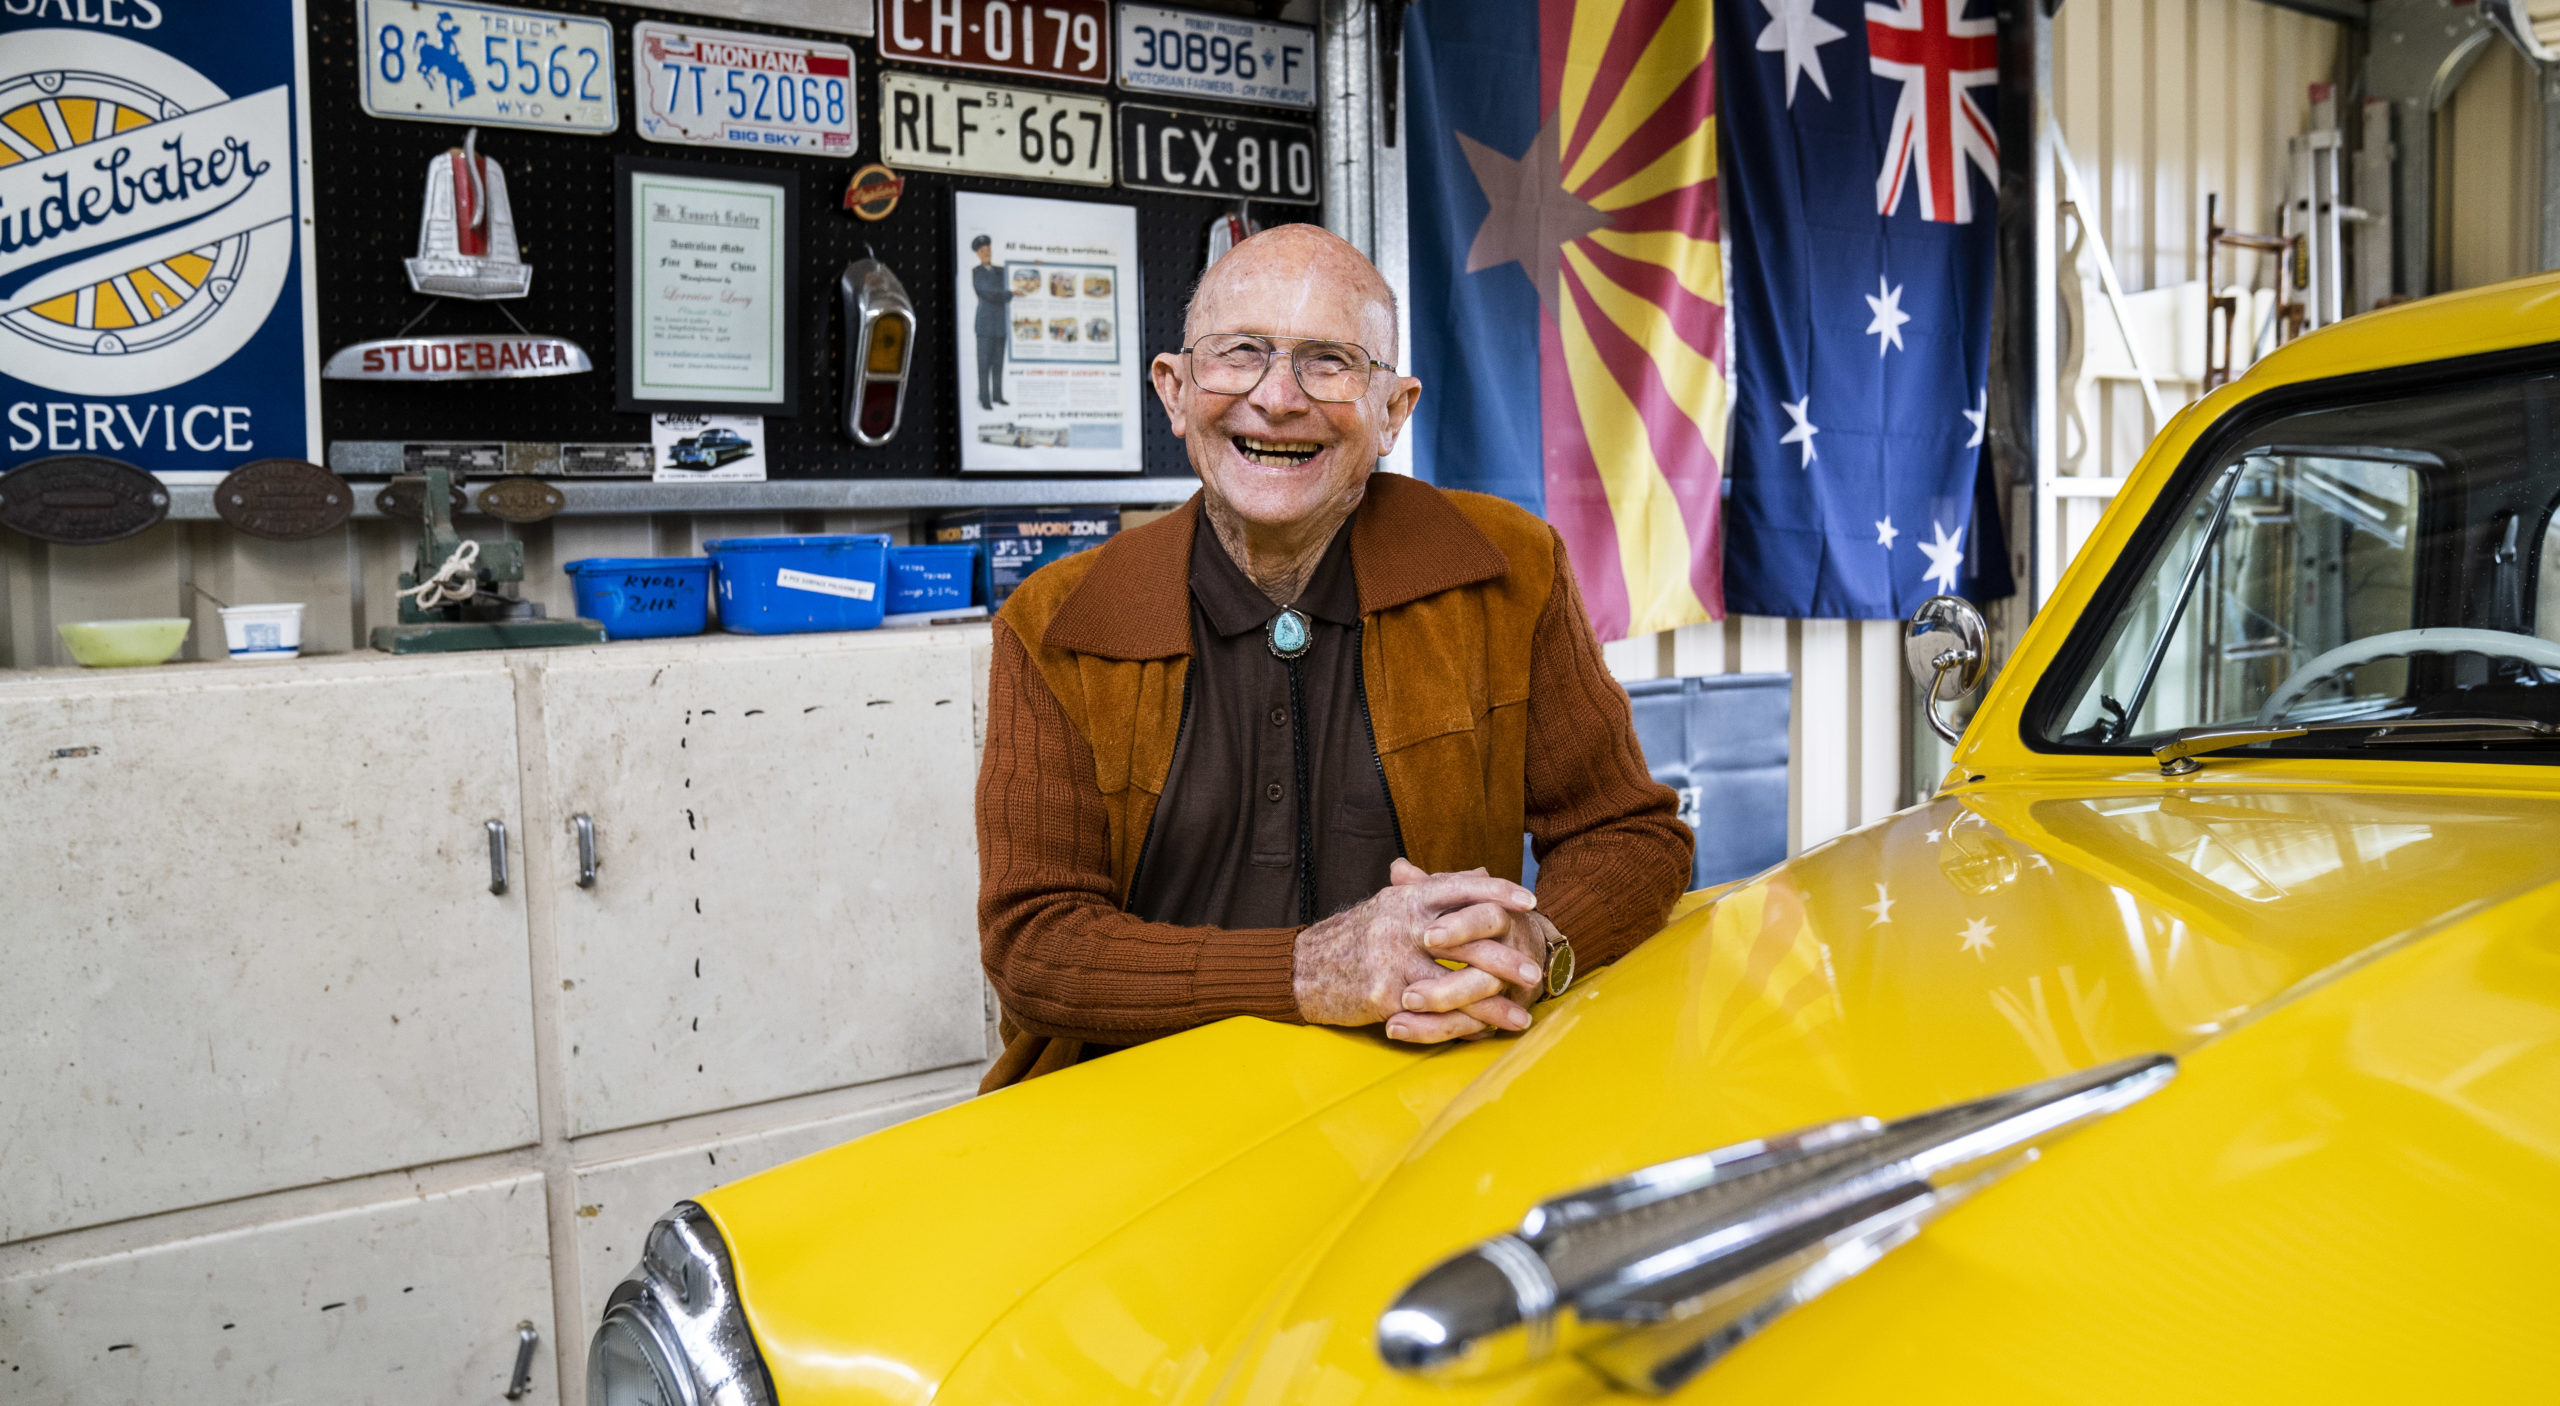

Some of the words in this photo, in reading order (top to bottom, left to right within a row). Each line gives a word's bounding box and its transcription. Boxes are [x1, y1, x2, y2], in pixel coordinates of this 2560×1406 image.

[480, 15, 558, 38] TRUCK
[1185, 17, 1216, 33] PRIMARY
[1217, 22, 1254, 37] PRODUCER
[379, 24, 405, 84] 8
[484, 35, 602, 102] 5562
[701, 44, 810, 73] MONTANA
[1133, 25, 1257, 80] 30896
[1281, 45, 1304, 85] F
[1128, 71, 1185, 88] VICTORIAN
[1187, 77, 1235, 95] FARMERS
[1241, 84, 1258, 97] ON
[1258, 86, 1279, 99] THE
[1278, 88, 1310, 103] MOVE
[496, 99, 544, 118] WYO
[728, 129, 759, 143] BIG
[763, 132, 801, 146] SKY
[1203, 118, 1238, 132] VIC
[0, 131, 271, 255] udebaker
[670, 239, 718, 252] Australian
[362, 342, 569, 373] STUDEBAKER
[8, 401, 255, 454] SERVICE
[1026, 520, 1109, 537] WORKZONE
